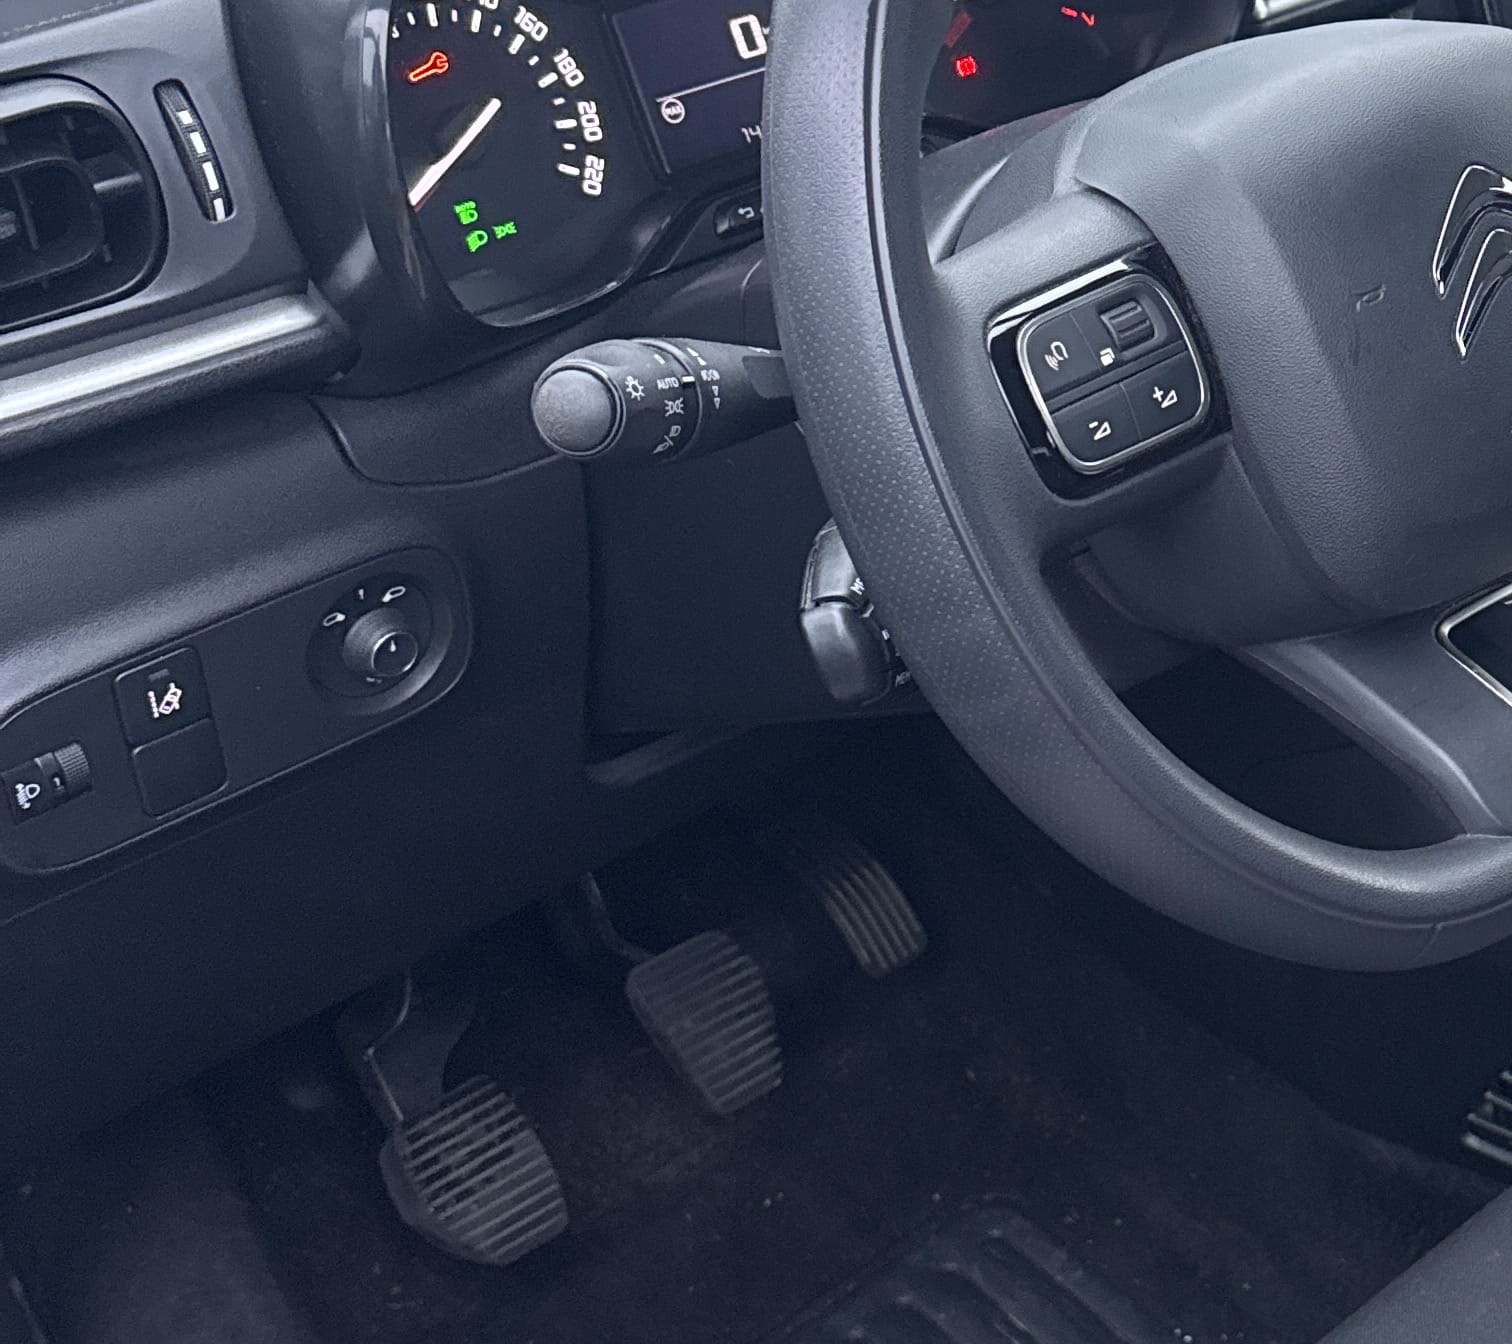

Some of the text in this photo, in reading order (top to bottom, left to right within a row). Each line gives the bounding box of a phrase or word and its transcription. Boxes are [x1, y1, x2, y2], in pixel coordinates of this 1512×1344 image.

[514, 5, 548, 42] 160
[730, 14, 767, 58] 0
[553, 48, 584, 87] 180
[577, 100, 603, 142] 200
[582, 155, 605, 196] 220
[656, 377, 680, 390] AUTO
